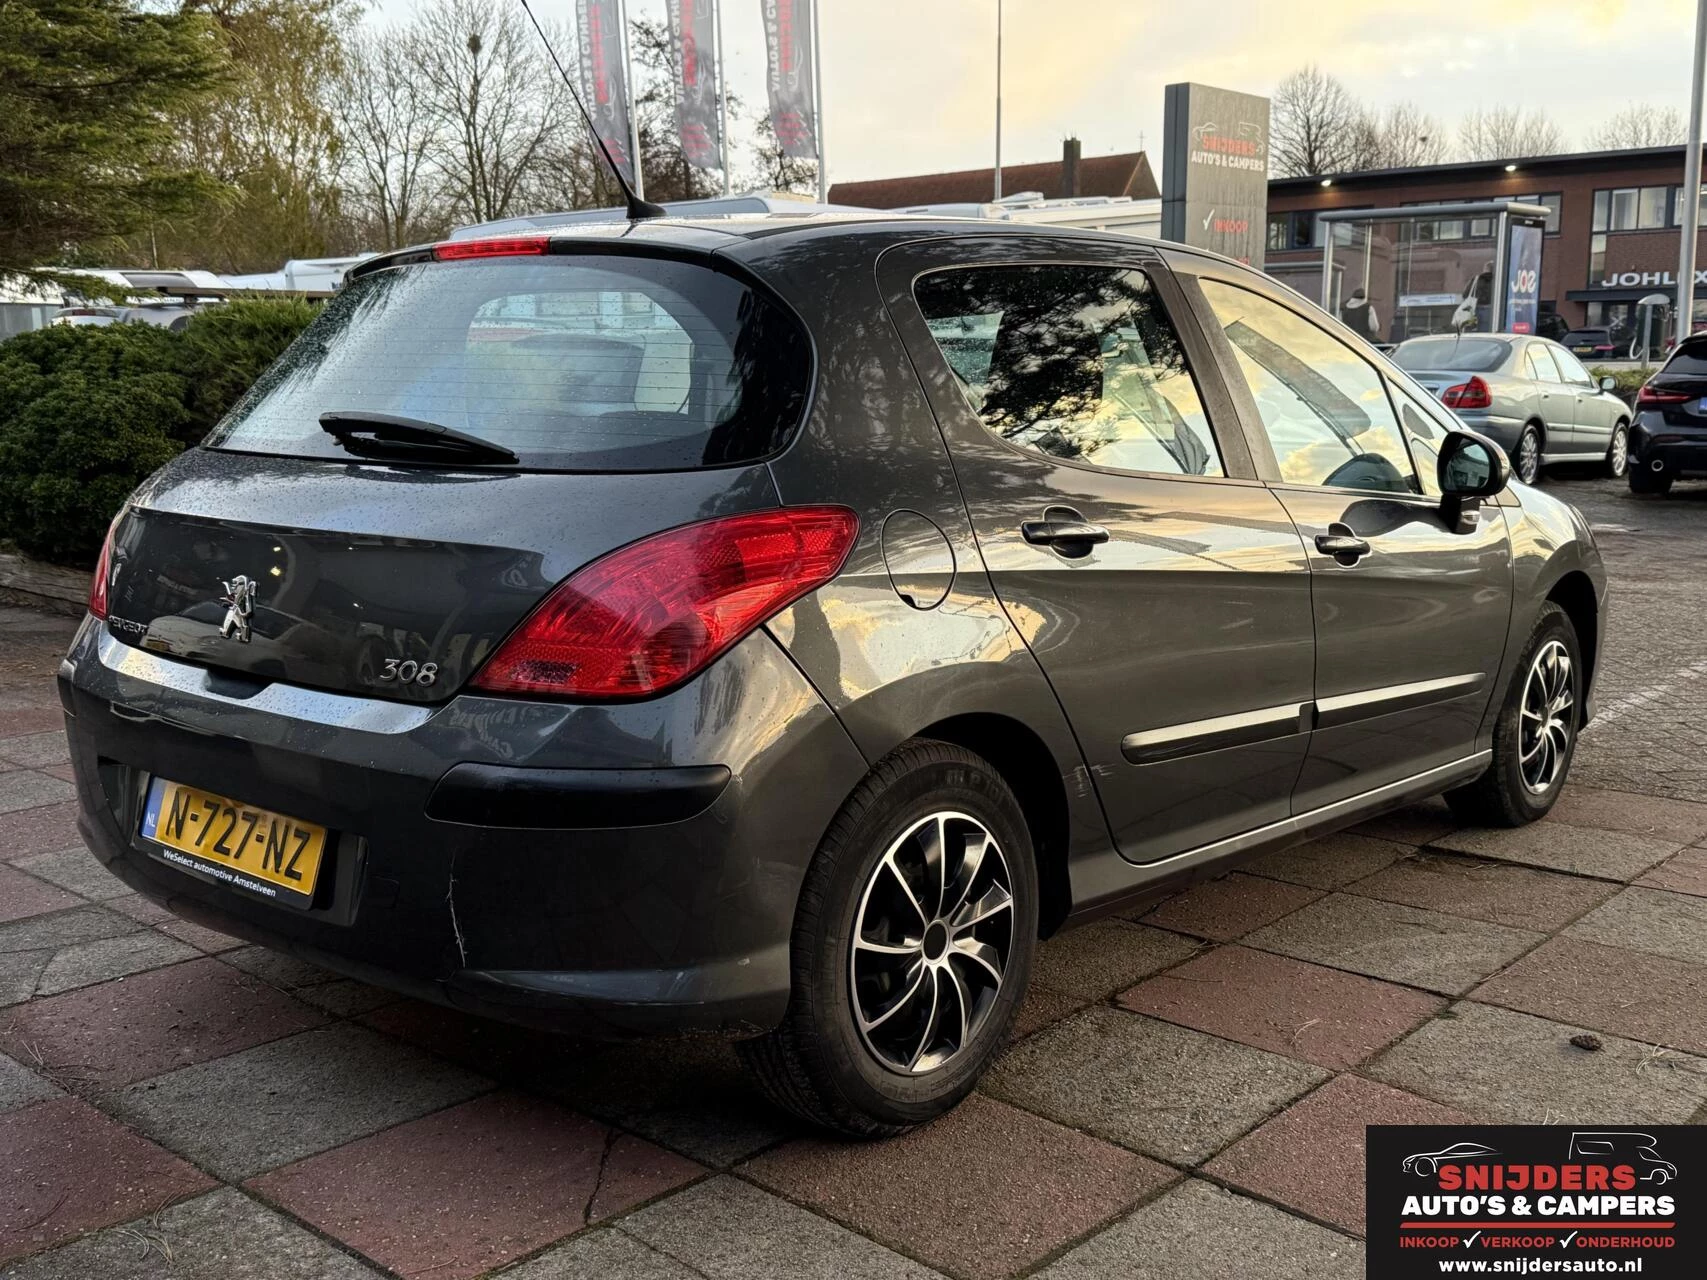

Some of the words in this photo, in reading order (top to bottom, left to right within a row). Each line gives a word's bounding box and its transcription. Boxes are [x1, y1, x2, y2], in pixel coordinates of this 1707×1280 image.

[1191, 150, 1221, 166] AUTO'S
[1221, 154, 1228, 168] &
[1228, 155, 1265, 172] CAMPERS
[1601, 271, 1707, 287] JOHLX
[379, 658, 439, 687] 308
[145, 811, 156, 828] NL
[165, 790, 311, 881] N-727-NZ
[163, 849, 193, 868] WeSelect
[193, 861, 233, 882] automotive
[233, 876, 277, 897] Amstelveen
